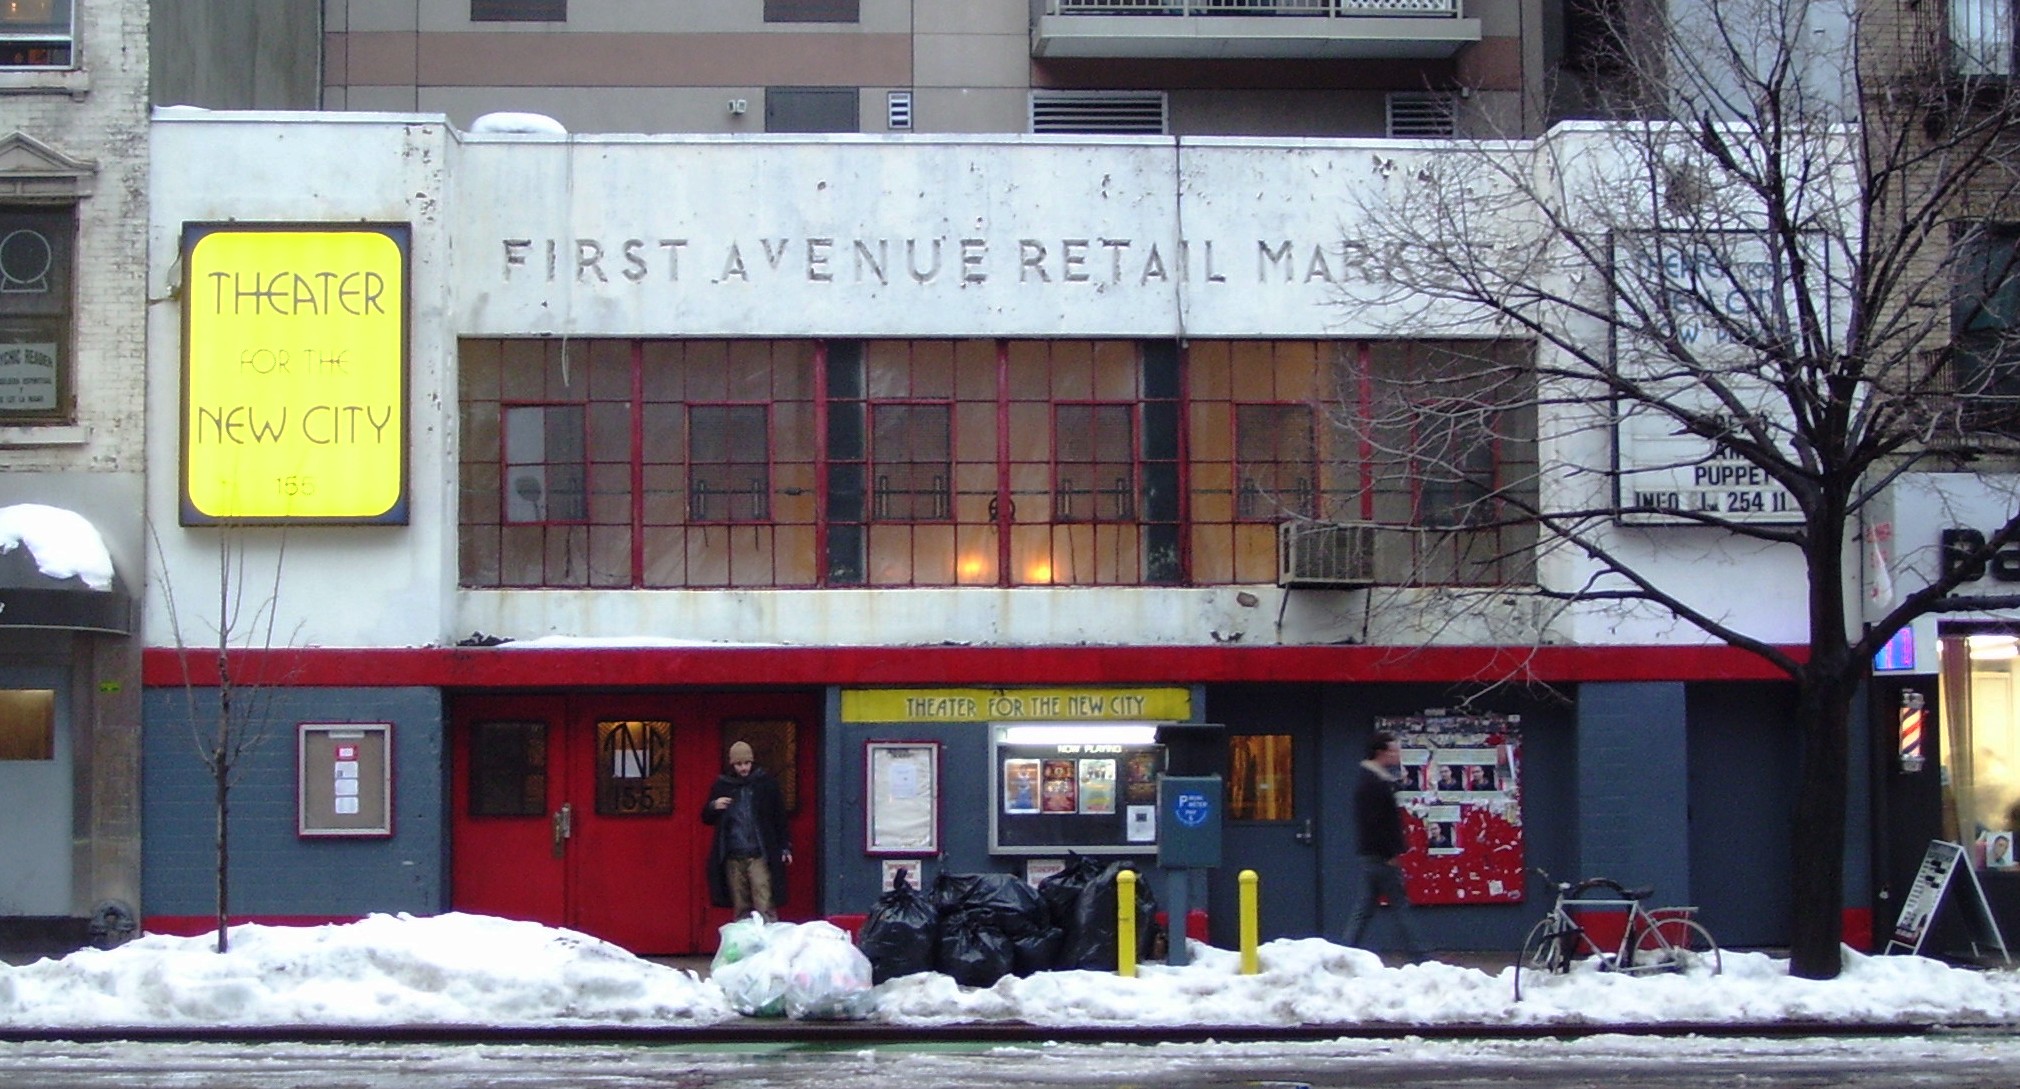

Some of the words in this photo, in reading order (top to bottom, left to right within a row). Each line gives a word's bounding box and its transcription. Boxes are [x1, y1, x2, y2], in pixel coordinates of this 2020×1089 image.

[502, 239, 689, 283] FIRST
[717, 238, 989, 283] AVENUE
[1017, 238, 1226, 284] RETAIL
[208, 271, 385, 316] THEATER
[240, 349, 291, 375] FOR
[303, 349, 350, 375] THE
[199, 406, 286, 444] NEW
[303, 405, 391, 444] CITY
[276, 475, 317, 496] 155
[1727, 491, 1764, 512] 254
[906, 697, 977, 717] THEATER
[989, 696, 1025, 717] FOR
[1031, 697, 1060, 716] THE
[1068, 696, 1103, 716] NEW
[1110, 695, 1144, 714] CITY
[1057, 744, 1080, 753] NOW
[1084, 744, 1122, 753] PLAYING
